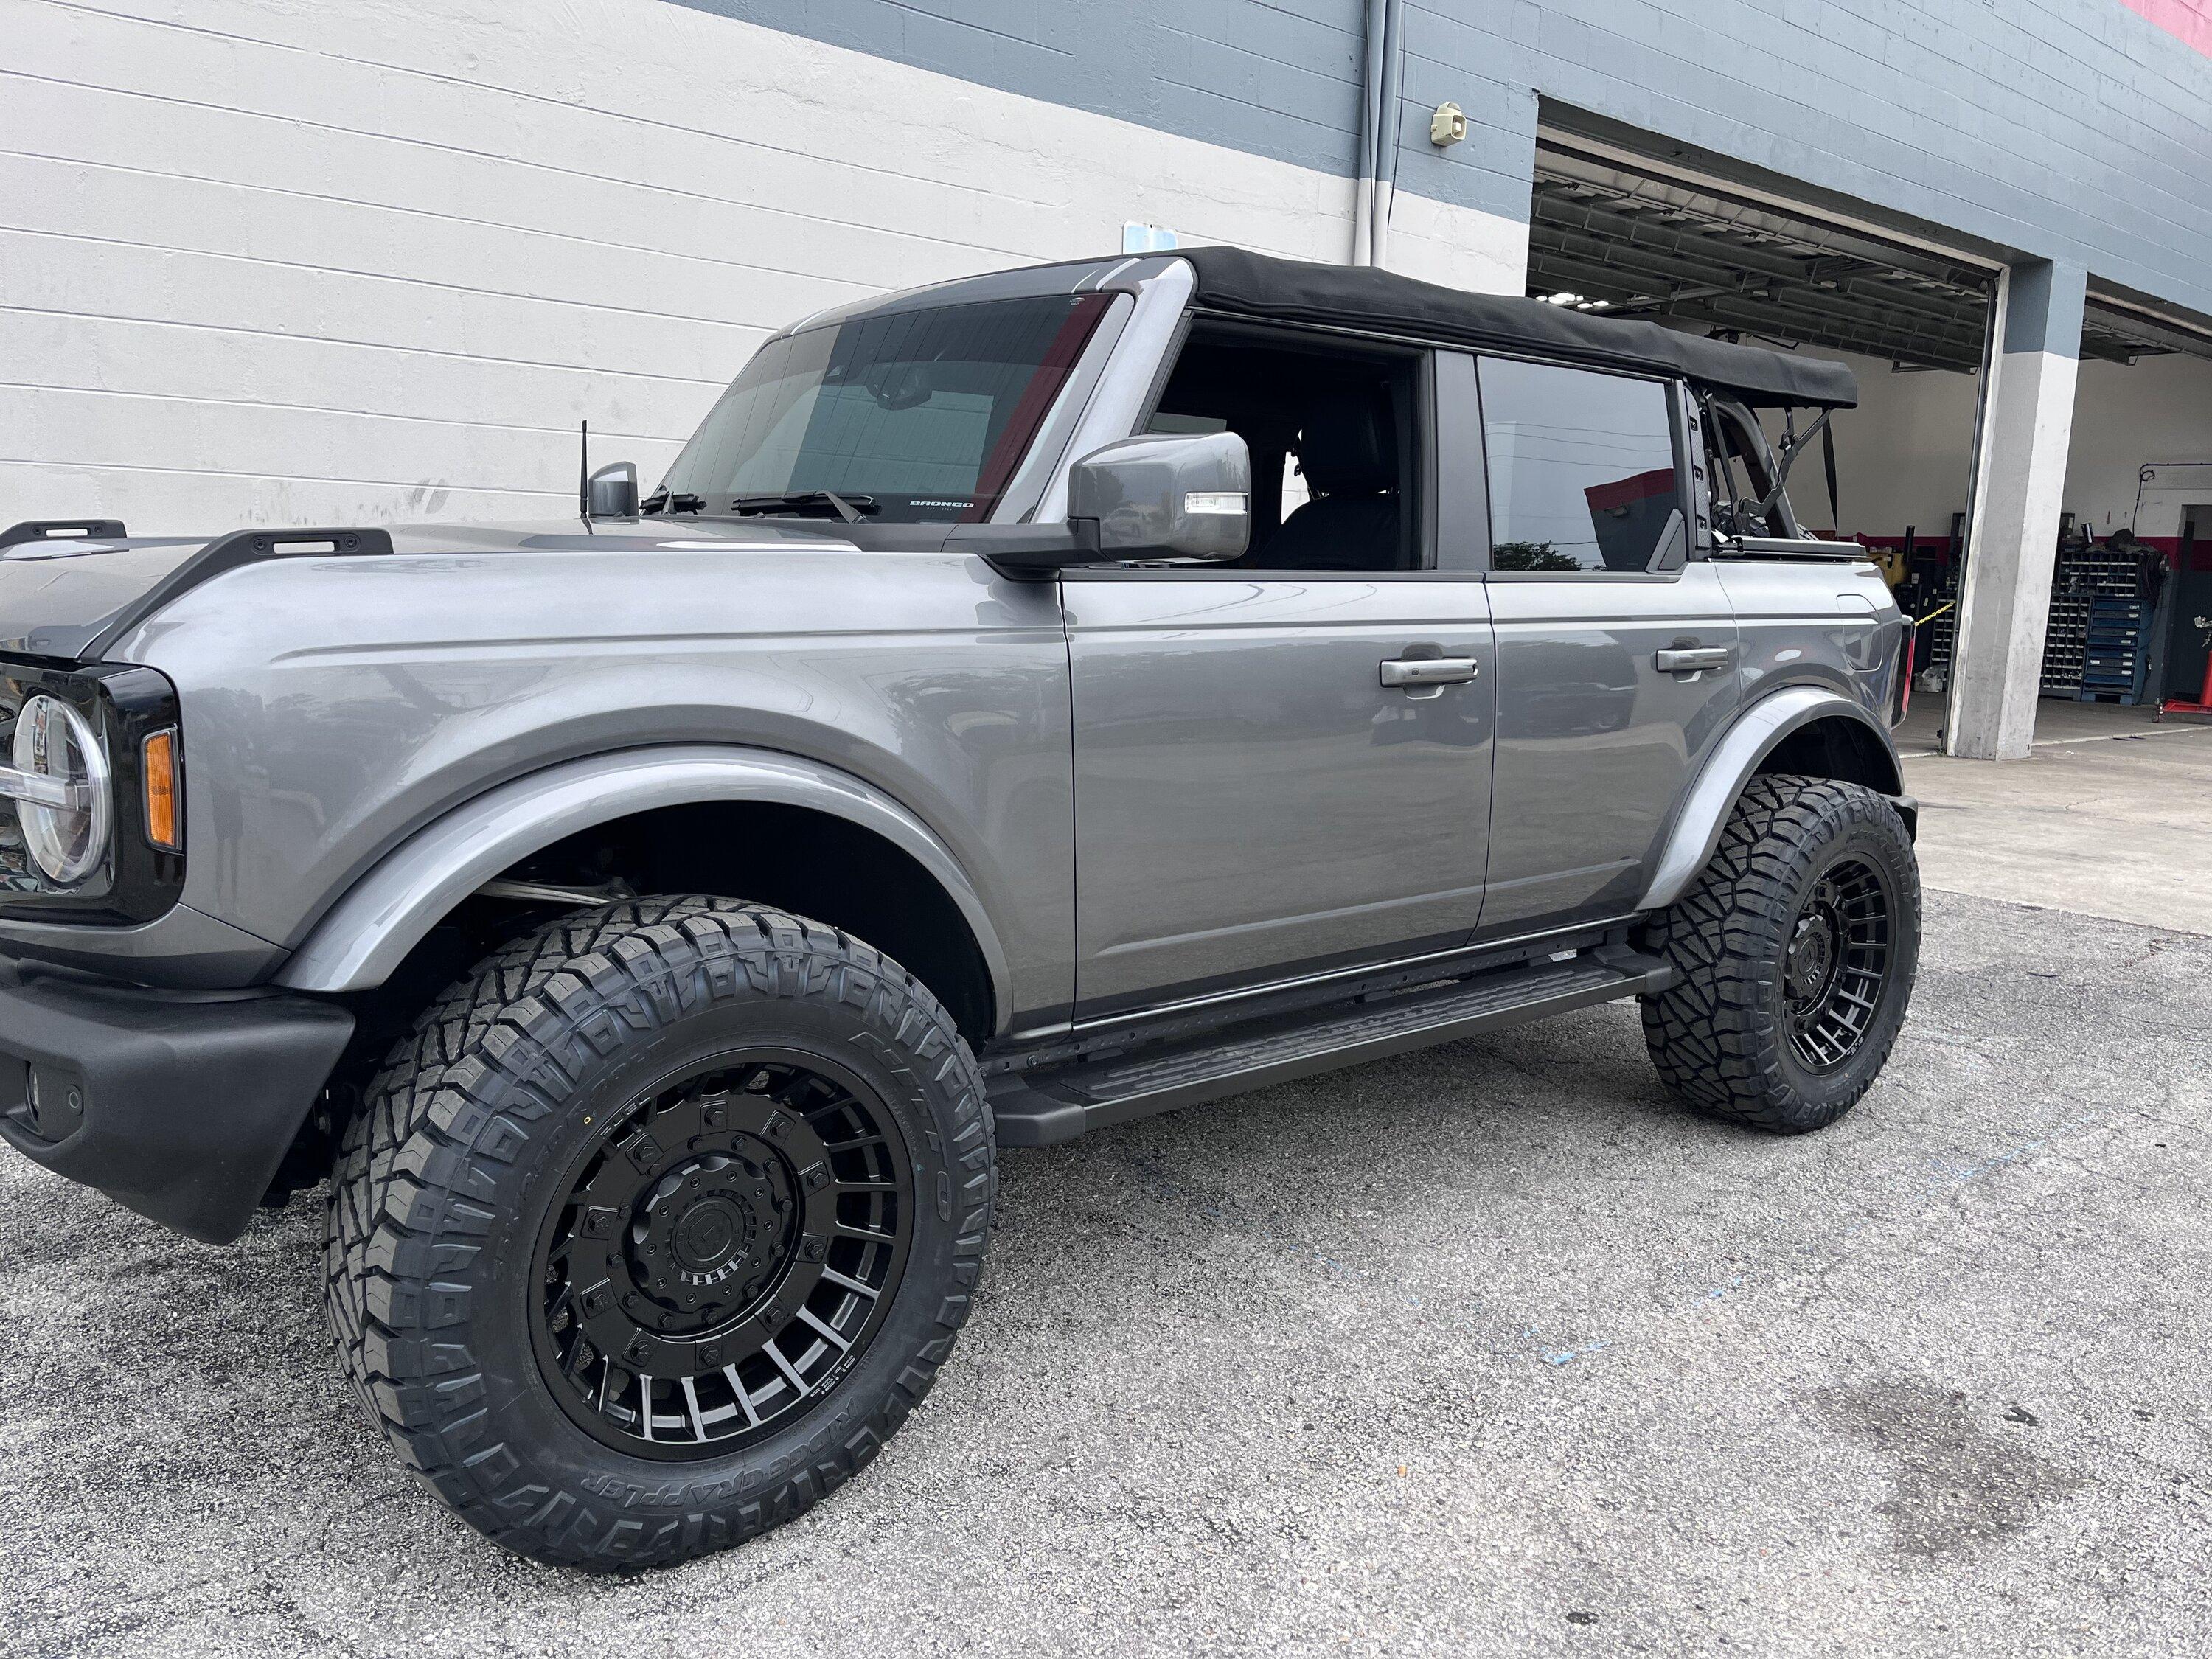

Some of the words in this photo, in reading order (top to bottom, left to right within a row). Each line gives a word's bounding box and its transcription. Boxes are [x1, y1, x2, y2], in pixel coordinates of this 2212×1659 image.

[599, 1096, 650, 1140] FUEL
[810, 1354, 856, 1398] FUEL
[768, 1397, 860, 1480] RIDGE
[580, 1467, 764, 1509] GRAPPLER
